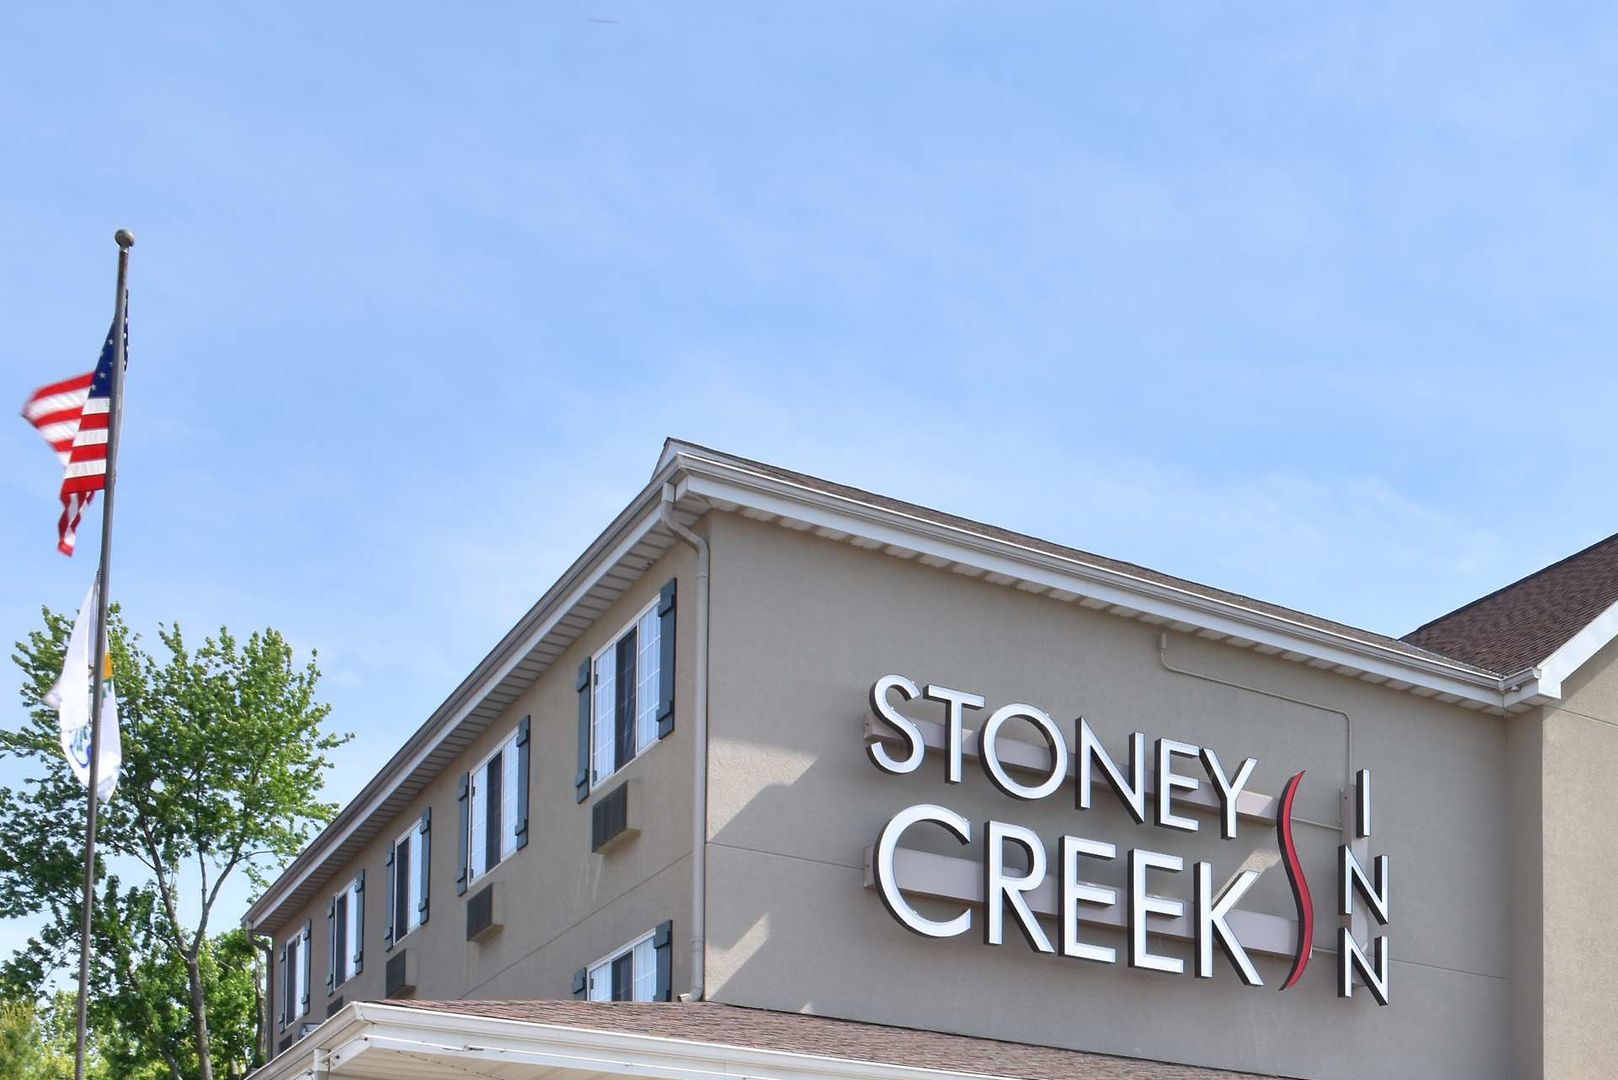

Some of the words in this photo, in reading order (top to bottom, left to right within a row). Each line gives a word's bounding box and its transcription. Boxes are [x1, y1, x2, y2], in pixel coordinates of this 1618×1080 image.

[867, 674, 1257, 839] STONEY
[874, 804, 1265, 987] CREEK
[1337, 768, 1390, 1006] INN
